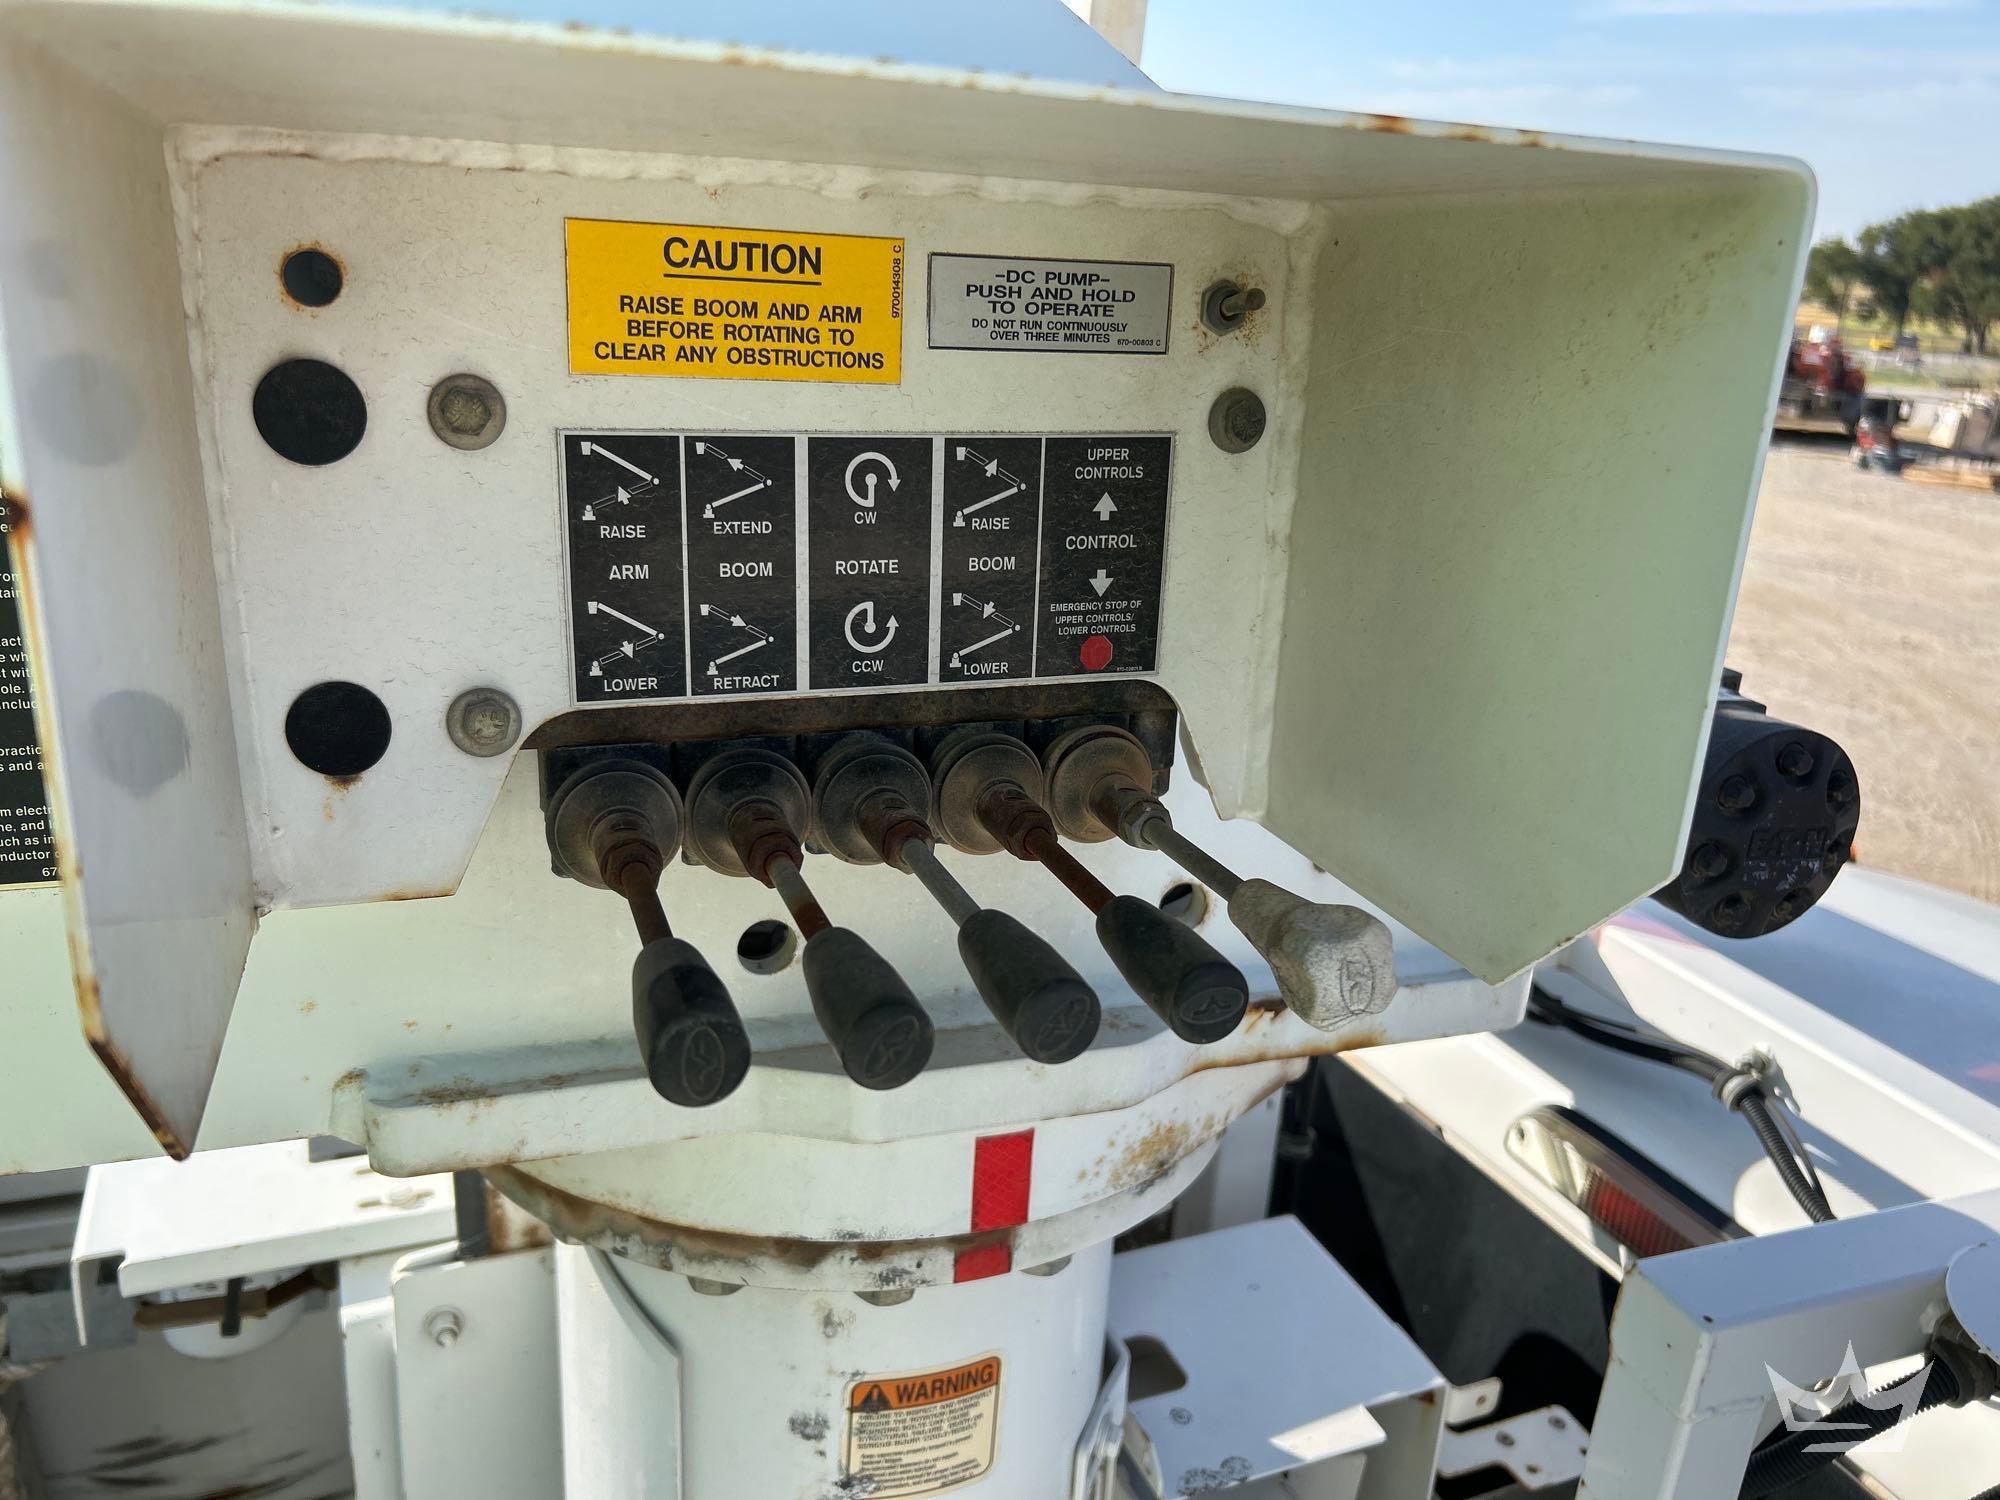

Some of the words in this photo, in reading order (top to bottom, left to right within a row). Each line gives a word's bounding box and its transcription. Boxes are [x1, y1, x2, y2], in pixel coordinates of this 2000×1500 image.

[663, 236, 822, 275] CAUTION
[893, 244, 902, 254] C
[891, 257, 902, 318] 970014308
[966, 284, 1022, 299] PUSH
[1031, 287, 1073, 301] AND
[1082, 289, 1136, 303] HOLD
[619, 295, 684, 316] RAISE
[693, 298, 758, 319] BOOM
[767, 302, 810, 321] AND
[818, 304, 862, 324] ARM
[988, 301, 1015, 314] TO
[1024, 301, 1115, 317] OPERATE
[971, 318, 988, 329] DO
[993, 319, 1016, 330] NOT
[1019, 320, 1043, 330] RUN
[1046, 320, 1128, 332] CONTINUOUSLY
[627, 320, 714, 340] BEFORE
[723, 324, 820, 345] ROTATING
[828, 328, 855, 346] TO
[990, 330, 1020, 341] OVER
[1023, 331, 1059, 342] THREE
[1063, 332, 1110, 343] MINUTES
[594, 341, 666, 362] CLEAR
[675, 345, 718, 364] ANY
[726, 347, 884, 370] OBSTRUCTIONS
[1087, 448, 1130, 461] UPPER
[1074, 466, 1144, 479] CONTROLS
[854, 511, 877, 524] CW
[971, 517, 1010, 530] RAISE
[600, 525, 646, 539] RAISE
[713, 521, 772, 535] EXTEND
[1065, 534, 1137, 550] CONTROL
[719, 562, 773, 578] BOOM
[835, 559, 899, 575] ROTATE
[968, 556, 1016, 572] BOOM
[609, 564, 649, 580] ARM
[1050, 602, 1103, 612] EMERGENCY
[1105, 601, 1128, 610] STOP
[1130, 600, 1142, 609] OF
[1055, 615, 1083, 625] UPPER
[1085, 613, 1135, 624] CONTROLS/
[1058, 626, 1088, 636] LOWER
[1090, 624, 1136, 635] CONTROLS
[852, 659, 884, 673] CCW
[964, 662, 1009, 675] LOWER
[604, 677, 658, 692] LOWER
[713, 674, 780, 690] RETRACT
[8, 760, 33, 771] and
[20, 820, 45, 831] and
[24, 836, 40, 846] as
[896, 1363, 994, 1403] WARNING
